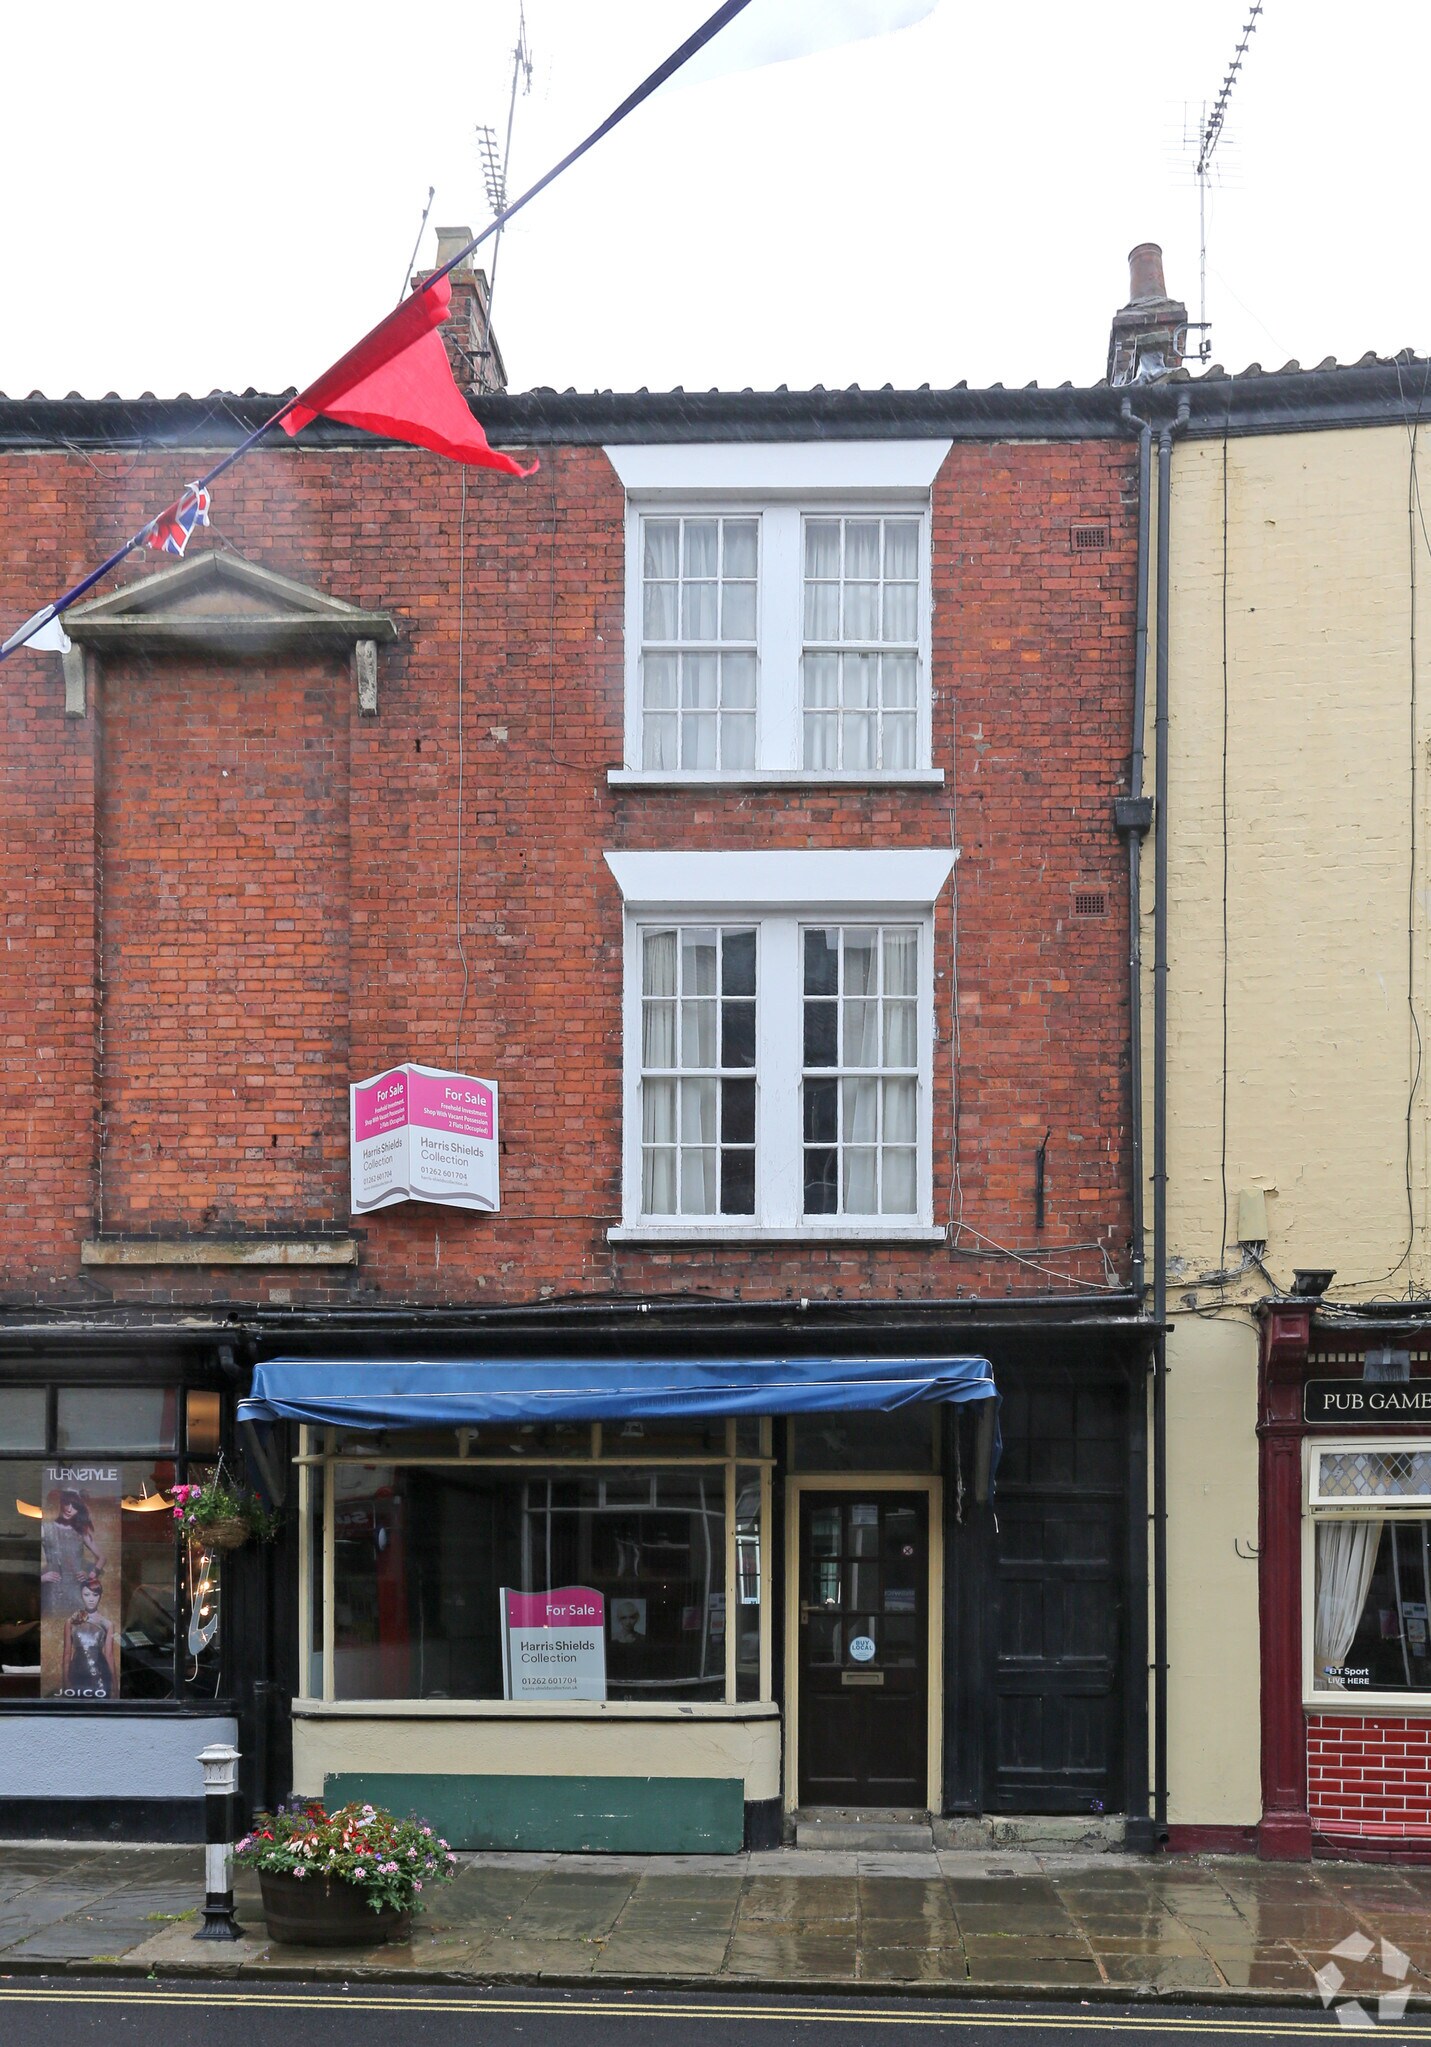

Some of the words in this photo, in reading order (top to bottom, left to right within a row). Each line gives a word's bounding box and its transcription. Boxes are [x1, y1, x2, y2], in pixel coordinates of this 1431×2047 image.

[377, 1090, 388, 1102] For
[390, 1083, 404, 1098] Sale
[445, 1088, 462, 1100] For
[465, 1092, 486, 1106] Sale
[441, 1103, 461, 1112] Freehold
[424, 1108, 435, 1117] Shop
[436, 1110, 447, 1118] With
[448, 1112, 463, 1120] Vacant
[464, 1116, 488, 1126] Possession
[452, 1122, 463, 1130] Flats
[464, 1124, 488, 1135] (Occupied)
[363, 1147, 380, 1159] Harris
[381, 1138, 402, 1153] Shields
[420, 1137, 450, 1151] Harris
[451, 1143, 484, 1157] Shields
[364, 1155, 393, 1171] Collection
[421, 1150, 468, 1167] Collection
[421, 1167, 441, 1176] 01262
[443, 1170, 467, 1180] 601704
[1323, 1394, 1364, 1410] PUB
[1369, 1393, 1431, 1409] GAME
[546, 1605, 566, 1616] For
[569, 1604, 595, 1616] Sale
[521, 1641, 554, 1651] Harris
[555, 1640, 595, 1651] Shields
[521, 1653, 577, 1663] Collection
[1345, 1668, 1369, 1676] Sport
[54, 1688, 107, 1698] JOICO
